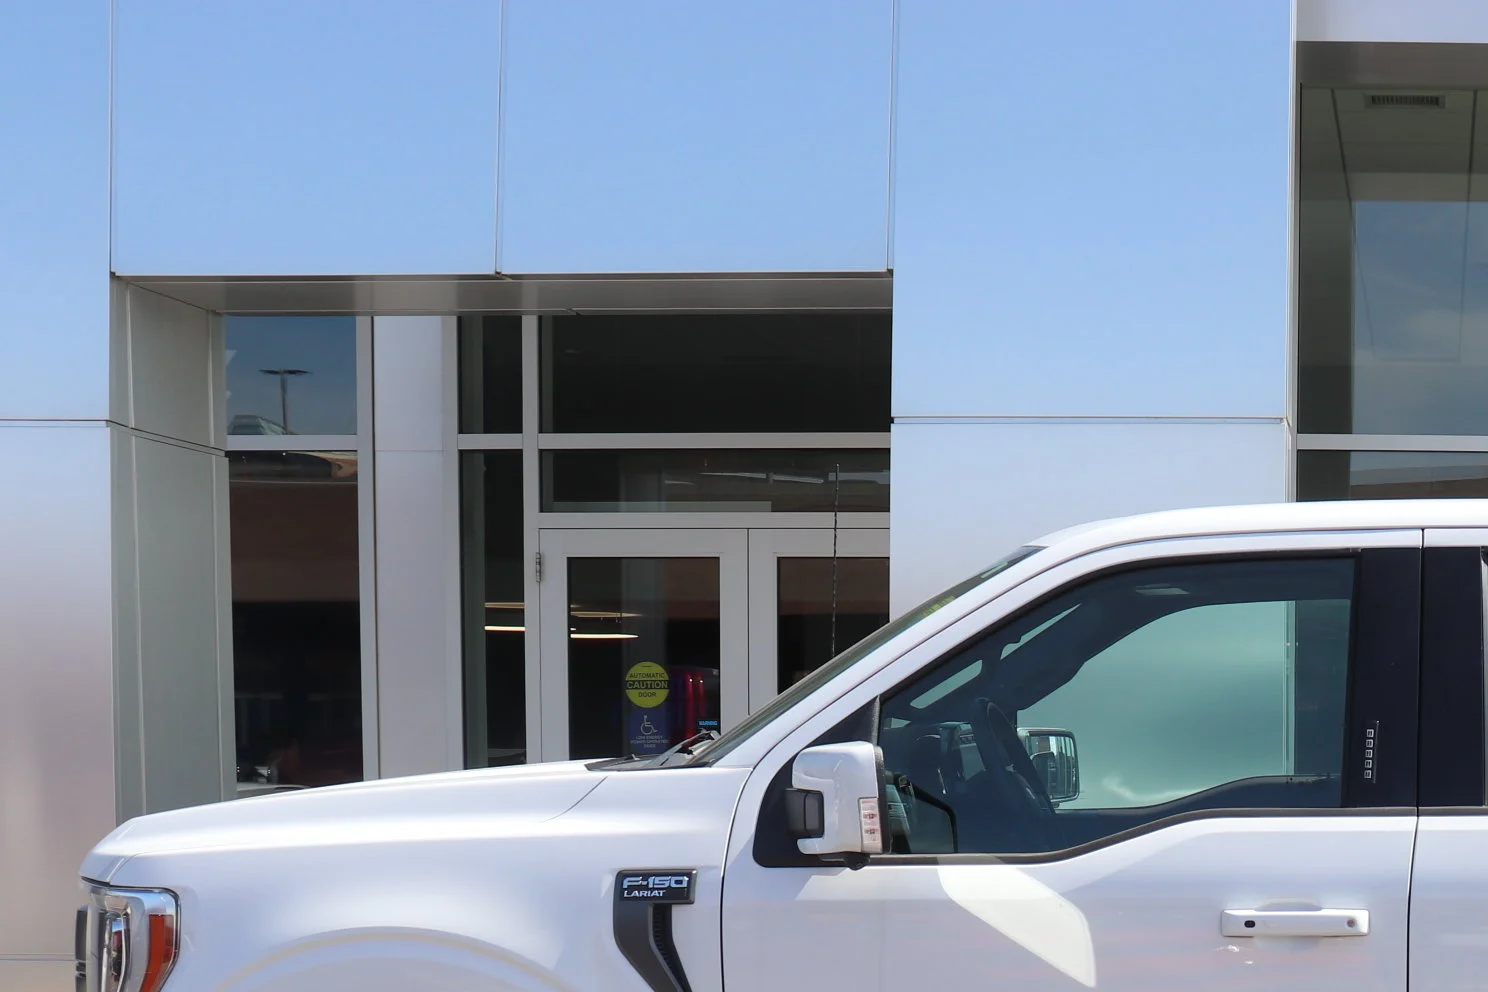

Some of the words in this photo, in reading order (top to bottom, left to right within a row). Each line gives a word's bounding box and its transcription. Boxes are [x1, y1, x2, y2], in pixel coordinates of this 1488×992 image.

[626, 681, 668, 689] CAUTION
[623, 876, 689, 888] F-150
[624, 889, 666, 897] LARIAT
